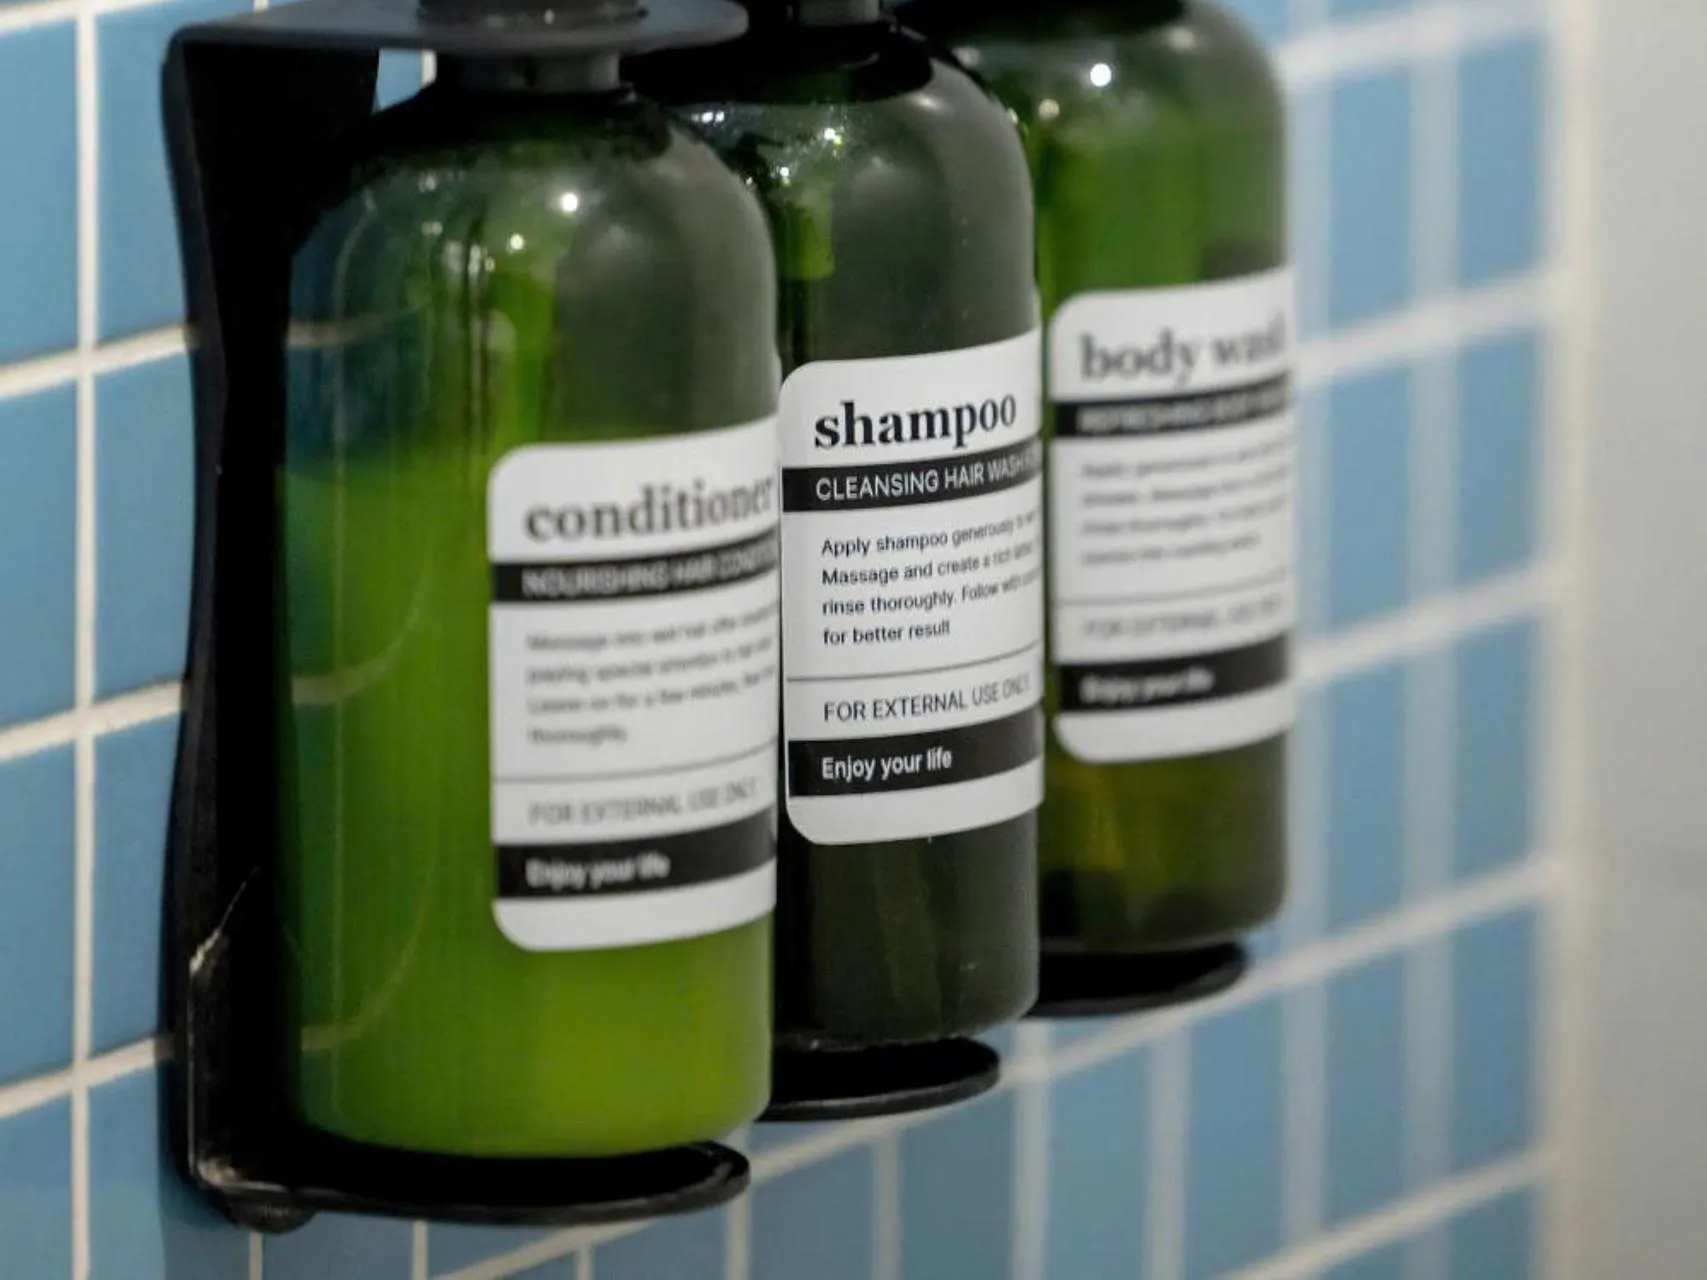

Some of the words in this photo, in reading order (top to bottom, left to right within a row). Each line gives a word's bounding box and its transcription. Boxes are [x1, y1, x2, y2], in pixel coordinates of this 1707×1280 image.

[1081, 326, 1201, 391] body
[814, 394, 1017, 449] shampoo
[816, 469, 939, 501] CLEANSING
[944, 461, 985, 490] HAIR
[526, 477, 774, 542] conditioner
[821, 536, 870, 558] Apply
[877, 530, 948, 552] shampoo
[822, 567, 899, 587] Massage
[904, 561, 933, 580] and
[937, 555, 980, 575] create
[822, 597, 865, 615] rinse
[871, 589, 957, 614] thoroughly.
[823, 629, 847, 645] for
[853, 626, 902, 644] better
[908, 620, 950, 639] result
[824, 700, 866, 721] FOR
[873, 690, 968, 720] EXTERNAL
[972, 682, 999, 705] USE
[822, 757, 875, 782] Enjoy
[880, 754, 922, 780] your
[927, 746, 952, 770] life
